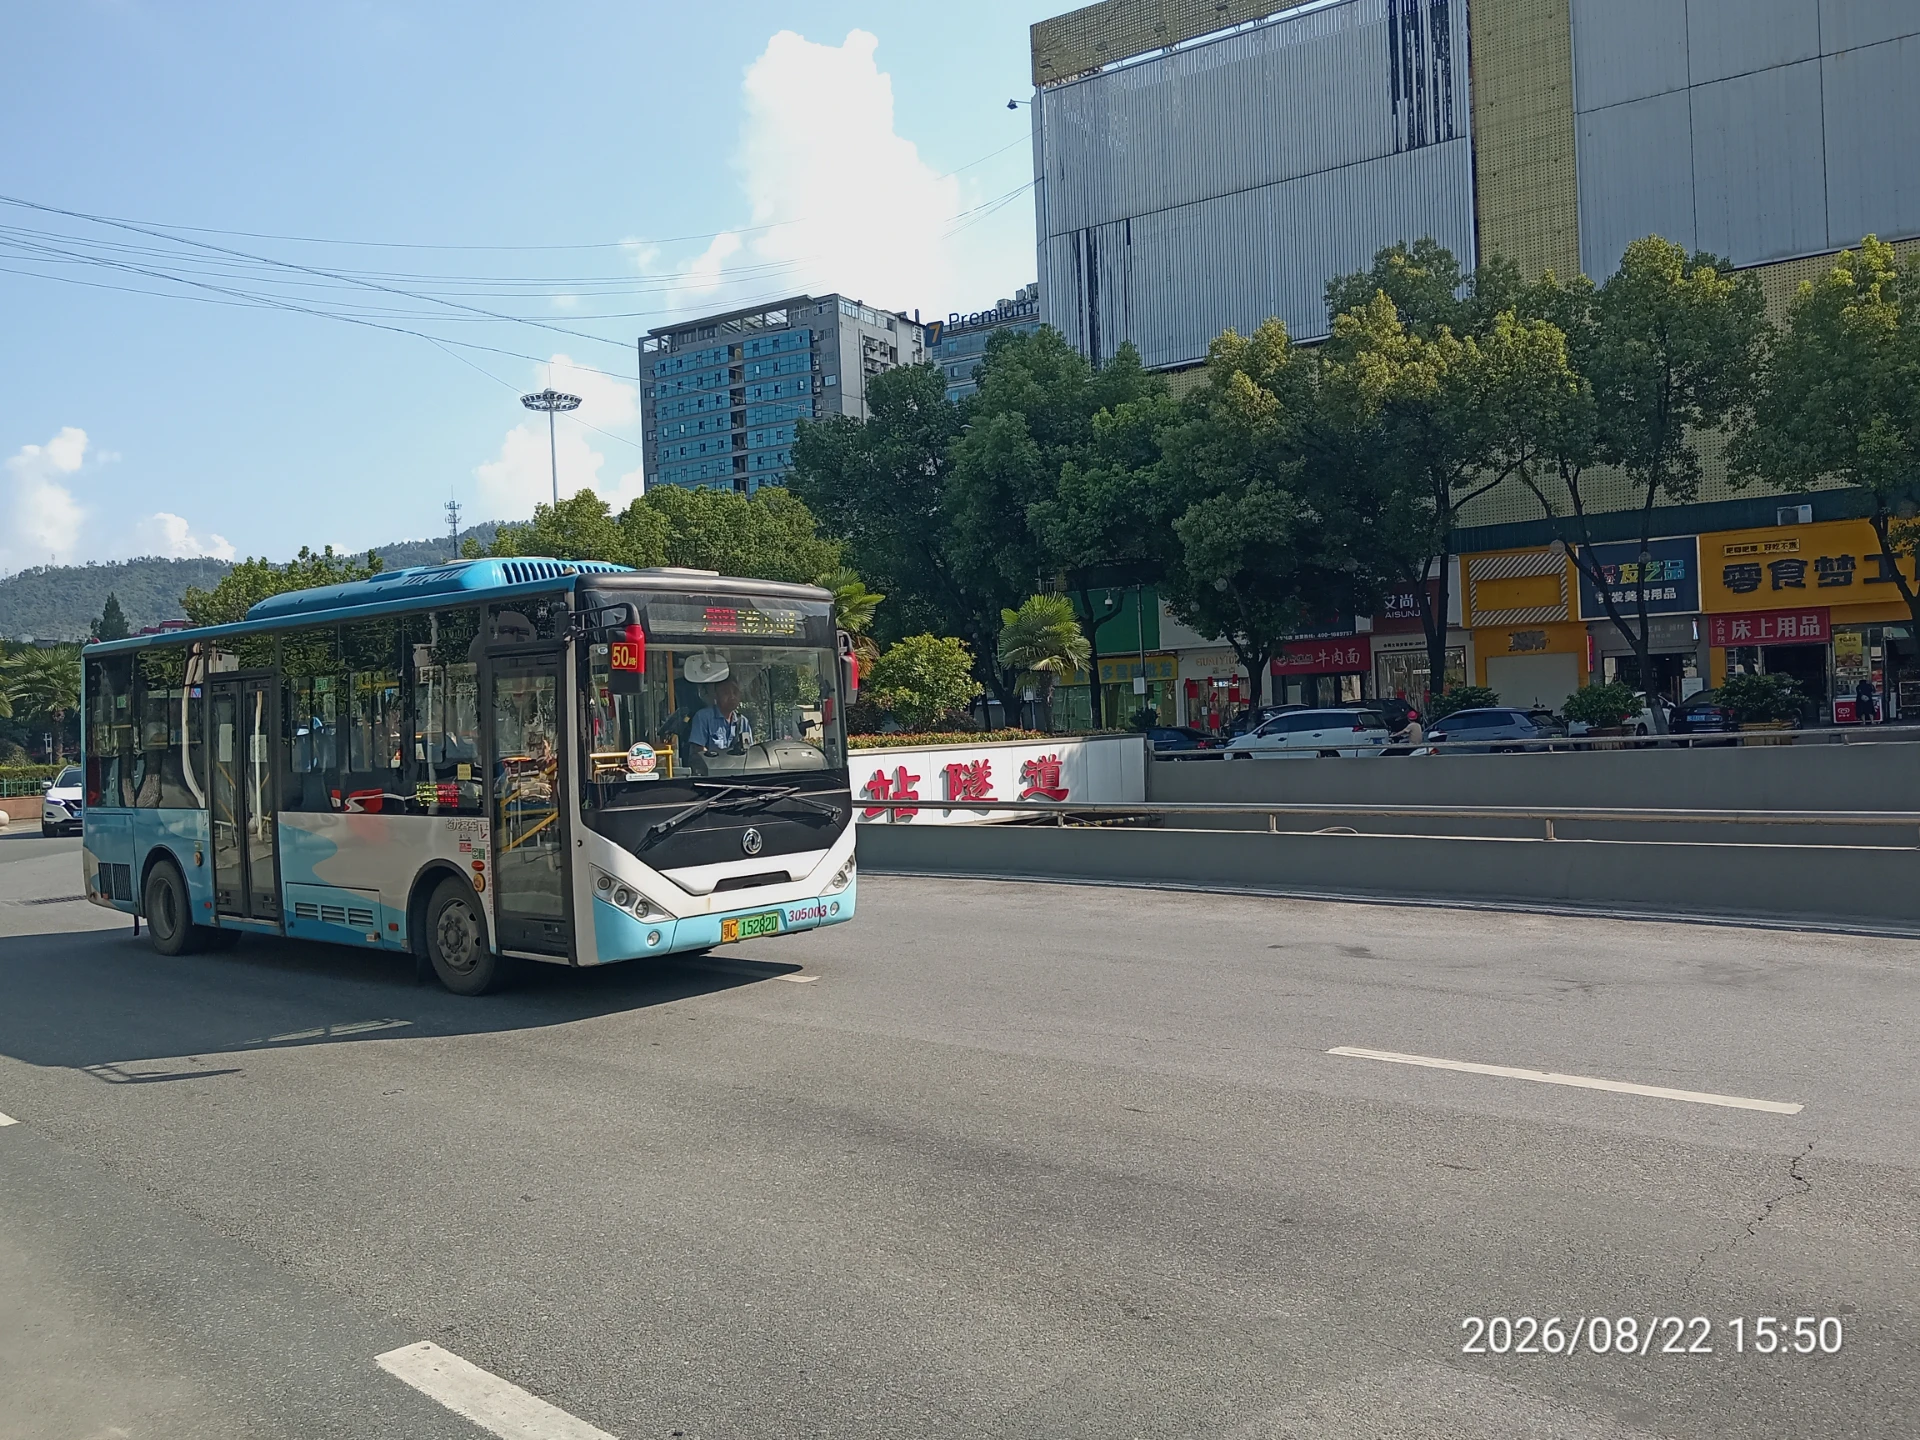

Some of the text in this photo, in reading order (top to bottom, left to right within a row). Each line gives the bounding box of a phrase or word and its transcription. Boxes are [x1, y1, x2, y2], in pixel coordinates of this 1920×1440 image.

[928, 301, 1033, 343] 7 Premium
[1723, 551, 1920, 594] 零食梦工
[1383, 592, 1431, 609] 艾尚
[1385, 610, 1422, 619] AISUNJ
[1731, 614, 1820, 640] 床上用品
[1315, 647, 1360, 668] 牛肉面
[865, 754, 1069, 817] 站隧道
[788, 905, 827, 922] 305003
